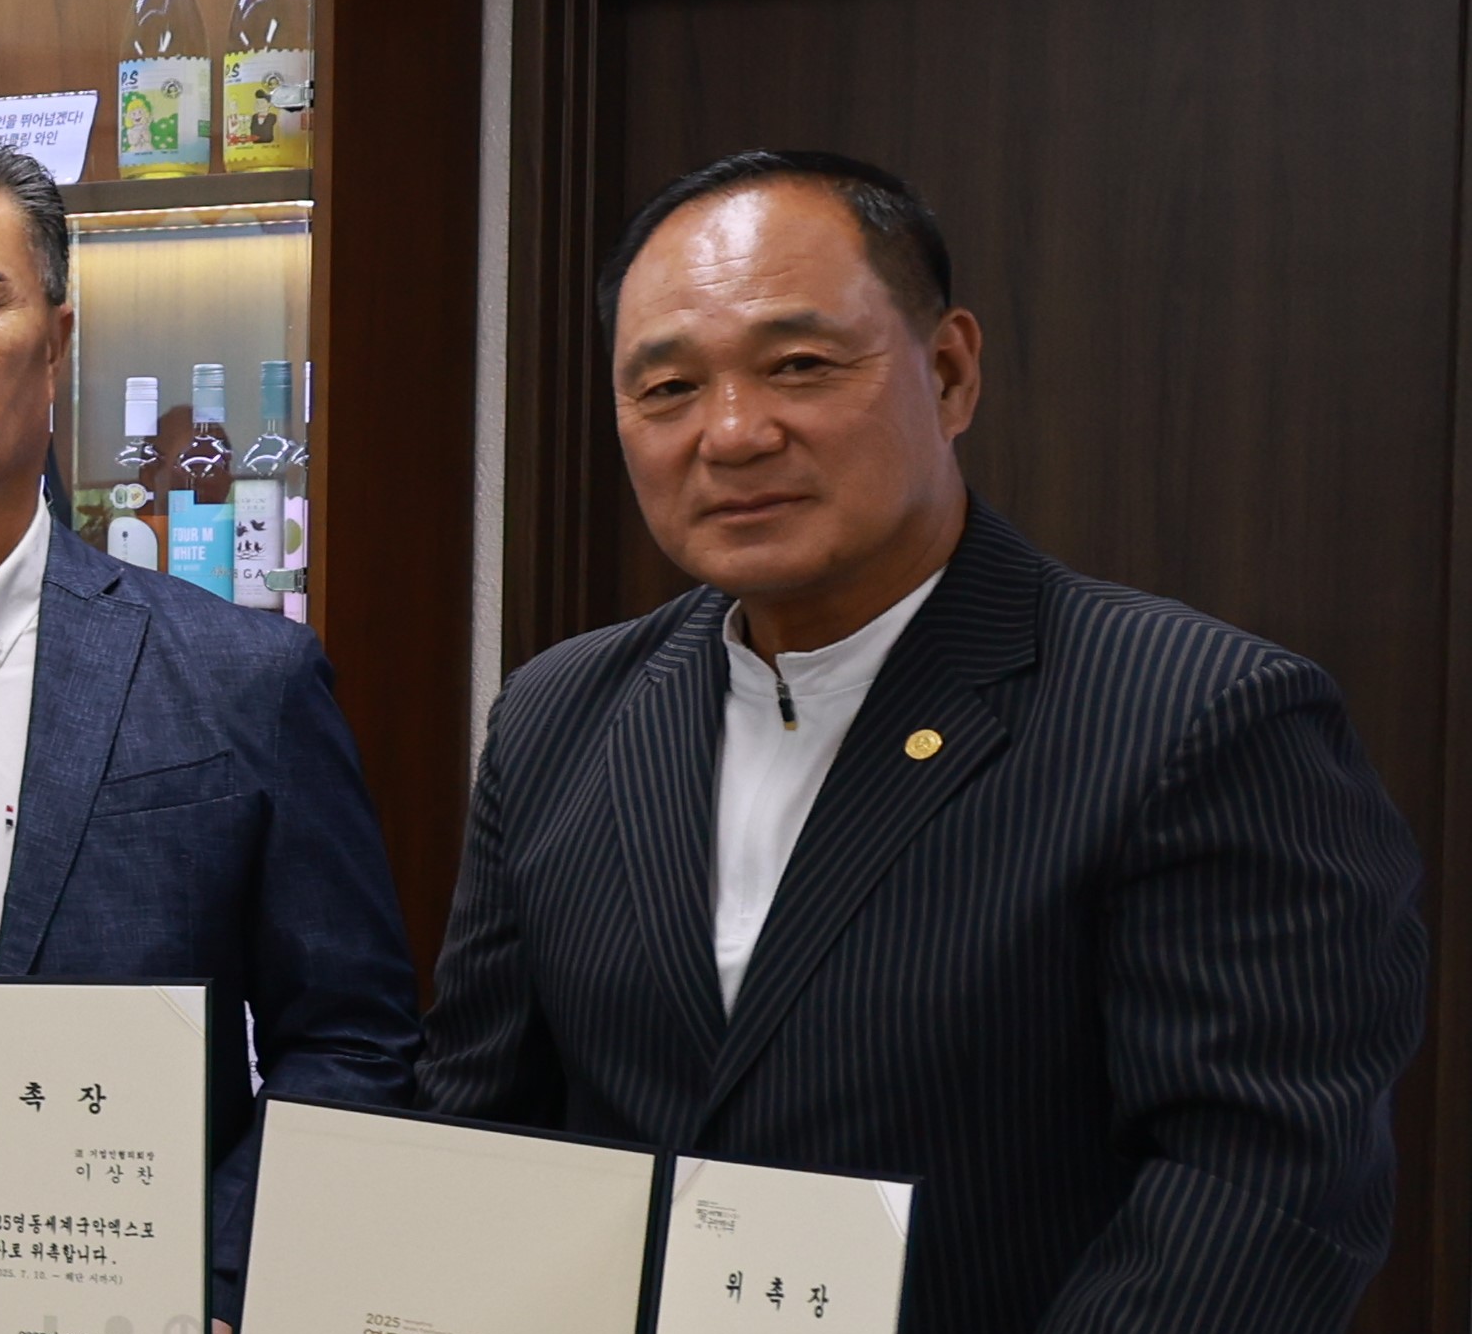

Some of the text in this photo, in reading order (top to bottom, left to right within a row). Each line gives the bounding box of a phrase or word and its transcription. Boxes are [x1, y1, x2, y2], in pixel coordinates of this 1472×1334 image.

[21, 110, 83, 127] 뛰어넘겠다!
[34, 130, 59, 147] 와인
[172, 527, 214, 542] FOUR M
[172, 546, 206, 561] WHITE
[19, 1082, 46, 1112] 촉
[77, 1084, 107, 1115] 장
[76, 1163, 91, 1182] 이
[105, 1164, 124, 1184] 상
[726, 1270, 829, 1318] 위 촉 장
[365, 1312, 401, 1329] 2025
